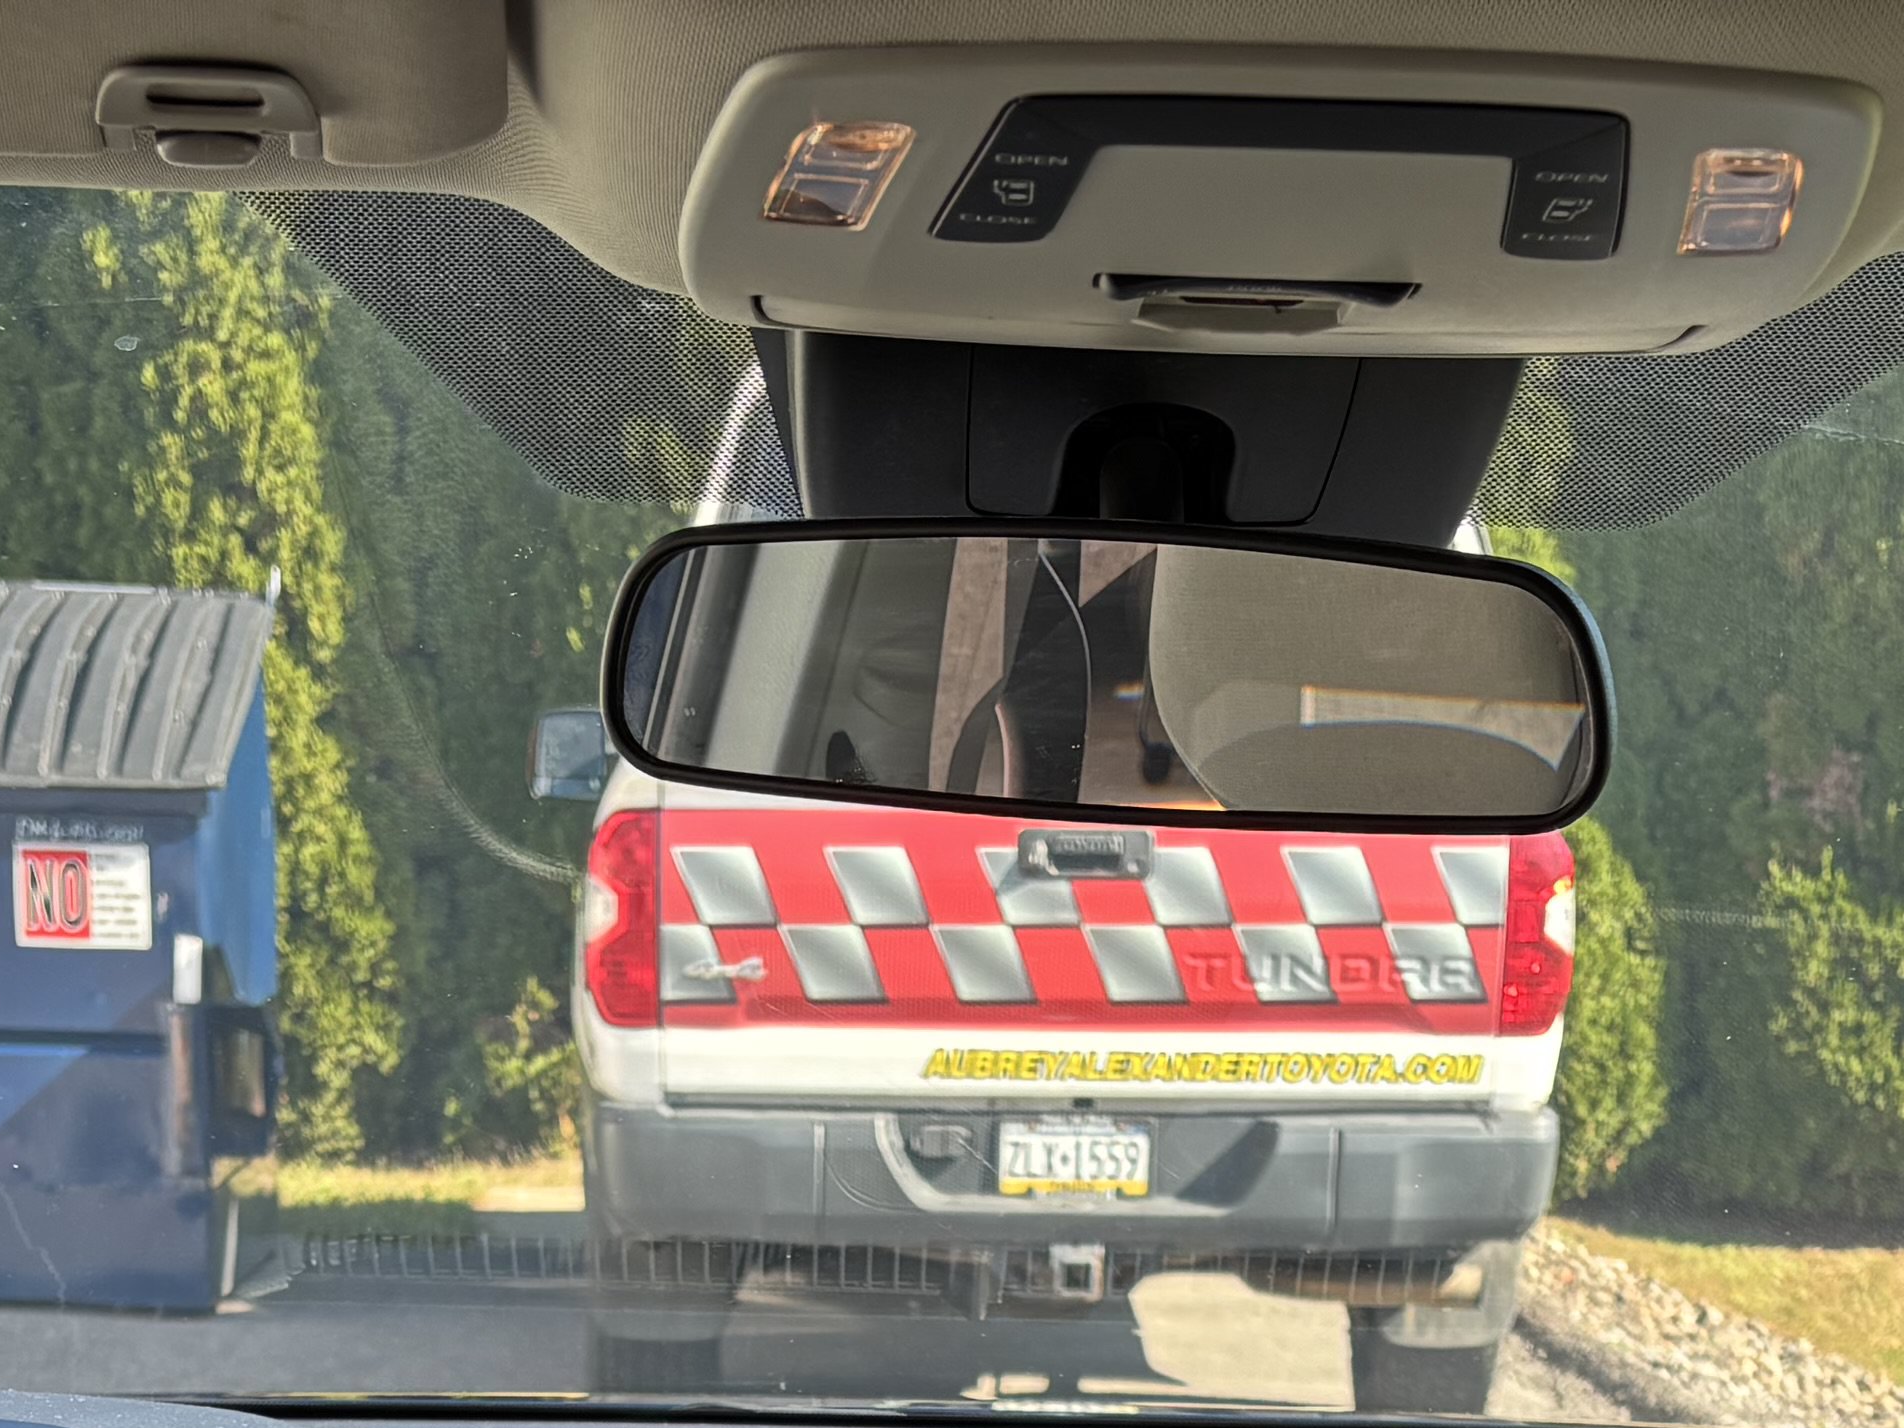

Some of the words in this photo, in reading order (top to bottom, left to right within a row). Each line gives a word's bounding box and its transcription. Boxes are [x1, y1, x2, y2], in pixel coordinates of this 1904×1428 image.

[995, 152, 1068, 167] OPEN
[1536, 170, 1609, 183] OPEN
[960, 211, 1037, 225] CLOSE
[26, 859, 89, 930] NO
[1184, 953, 1482, 993] TUNDRA
[922, 1048, 1485, 1084] AUBREYALEXANDERTOYOTA.COM
